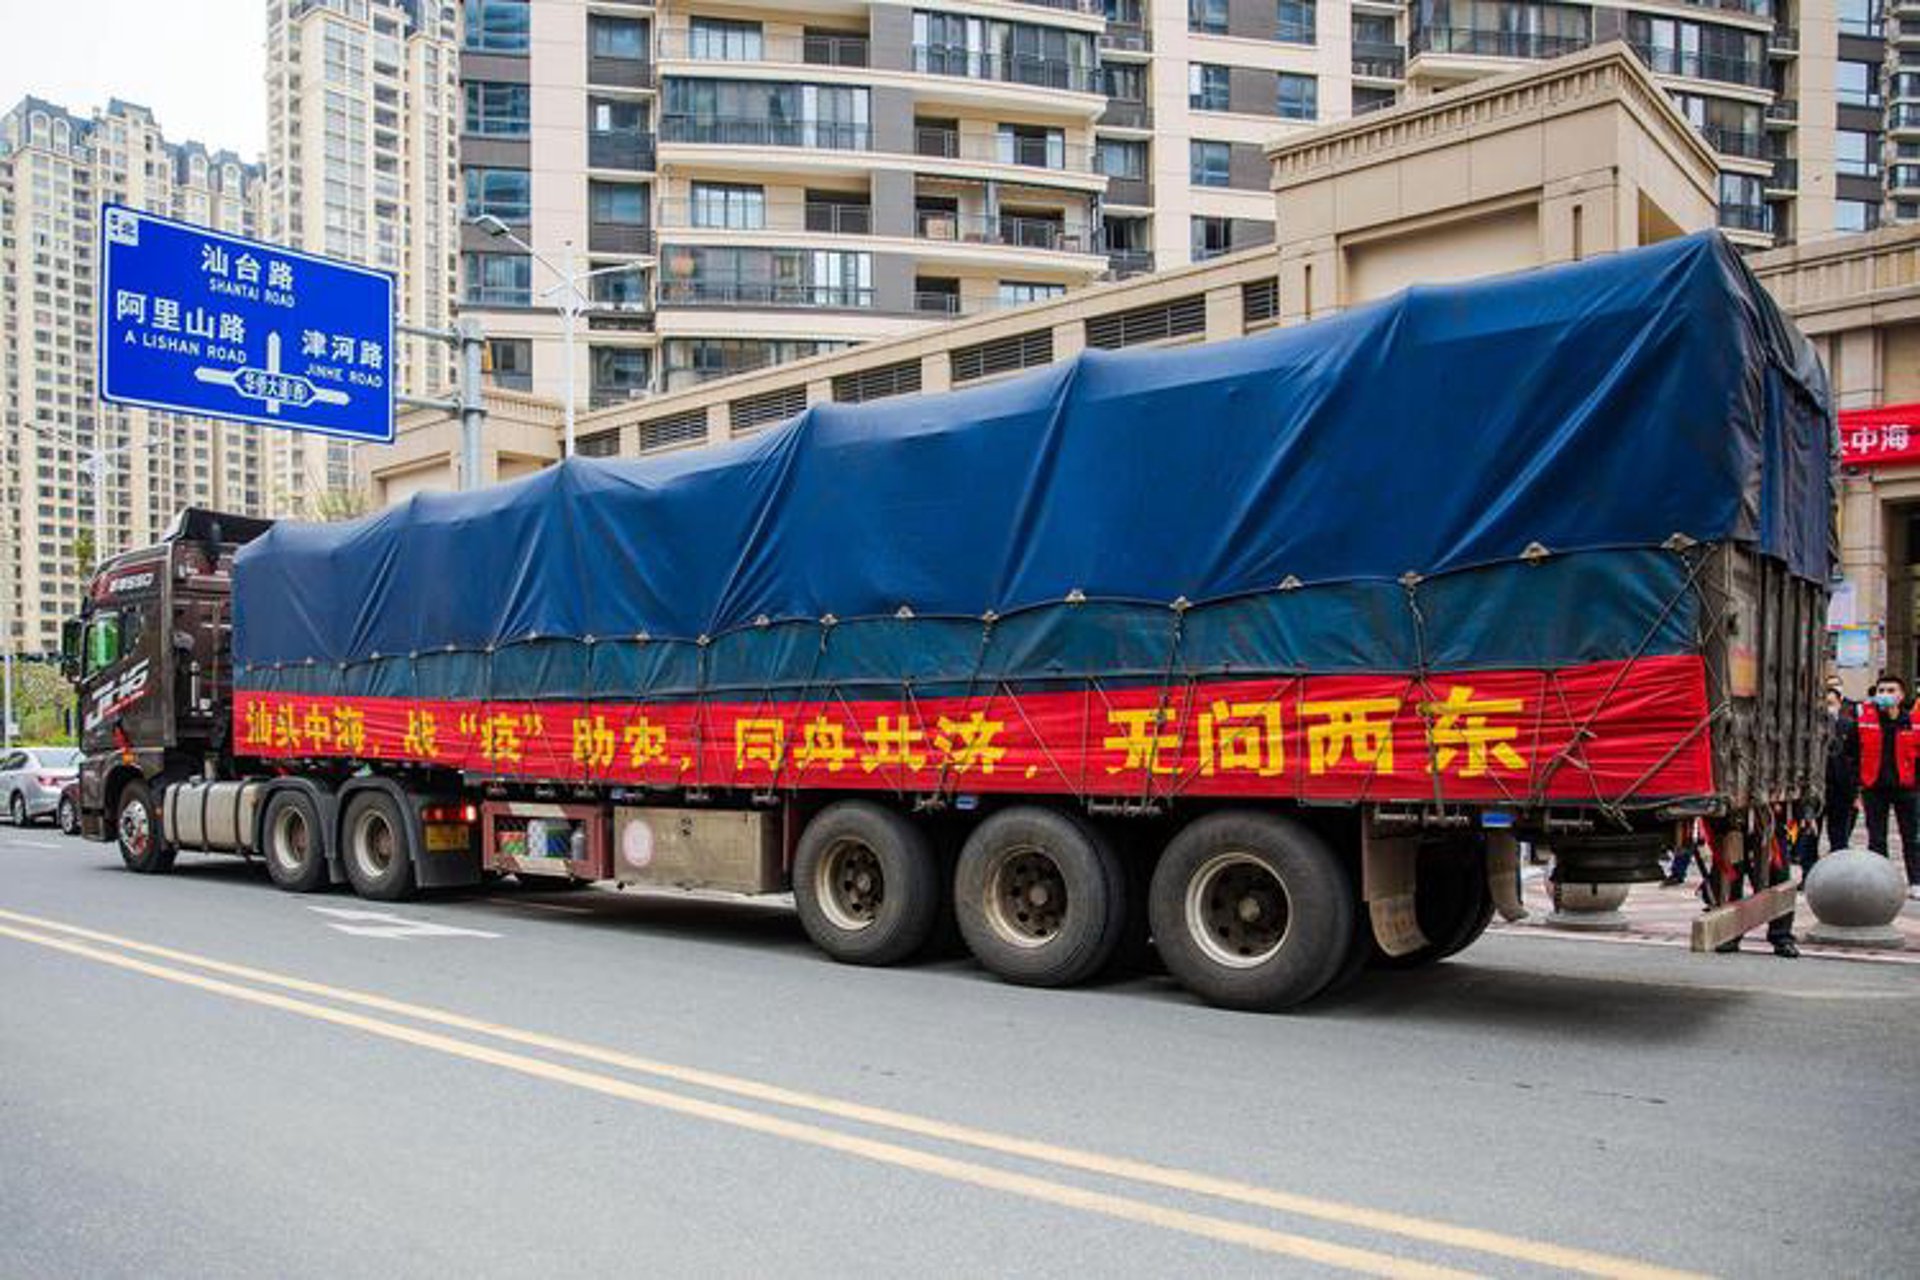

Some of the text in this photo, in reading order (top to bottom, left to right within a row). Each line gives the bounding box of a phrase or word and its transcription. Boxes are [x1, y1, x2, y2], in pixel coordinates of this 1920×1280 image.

[201, 243, 293, 291] 汕台路
[209, 278, 295, 308] SHANTAI ROAD
[116, 289, 246, 344] 阿里山路
[124, 330, 247, 364] A LISHAN ROAD
[301, 329, 383, 369] 津河路
[305, 363, 383, 388] JINHE ROAD
